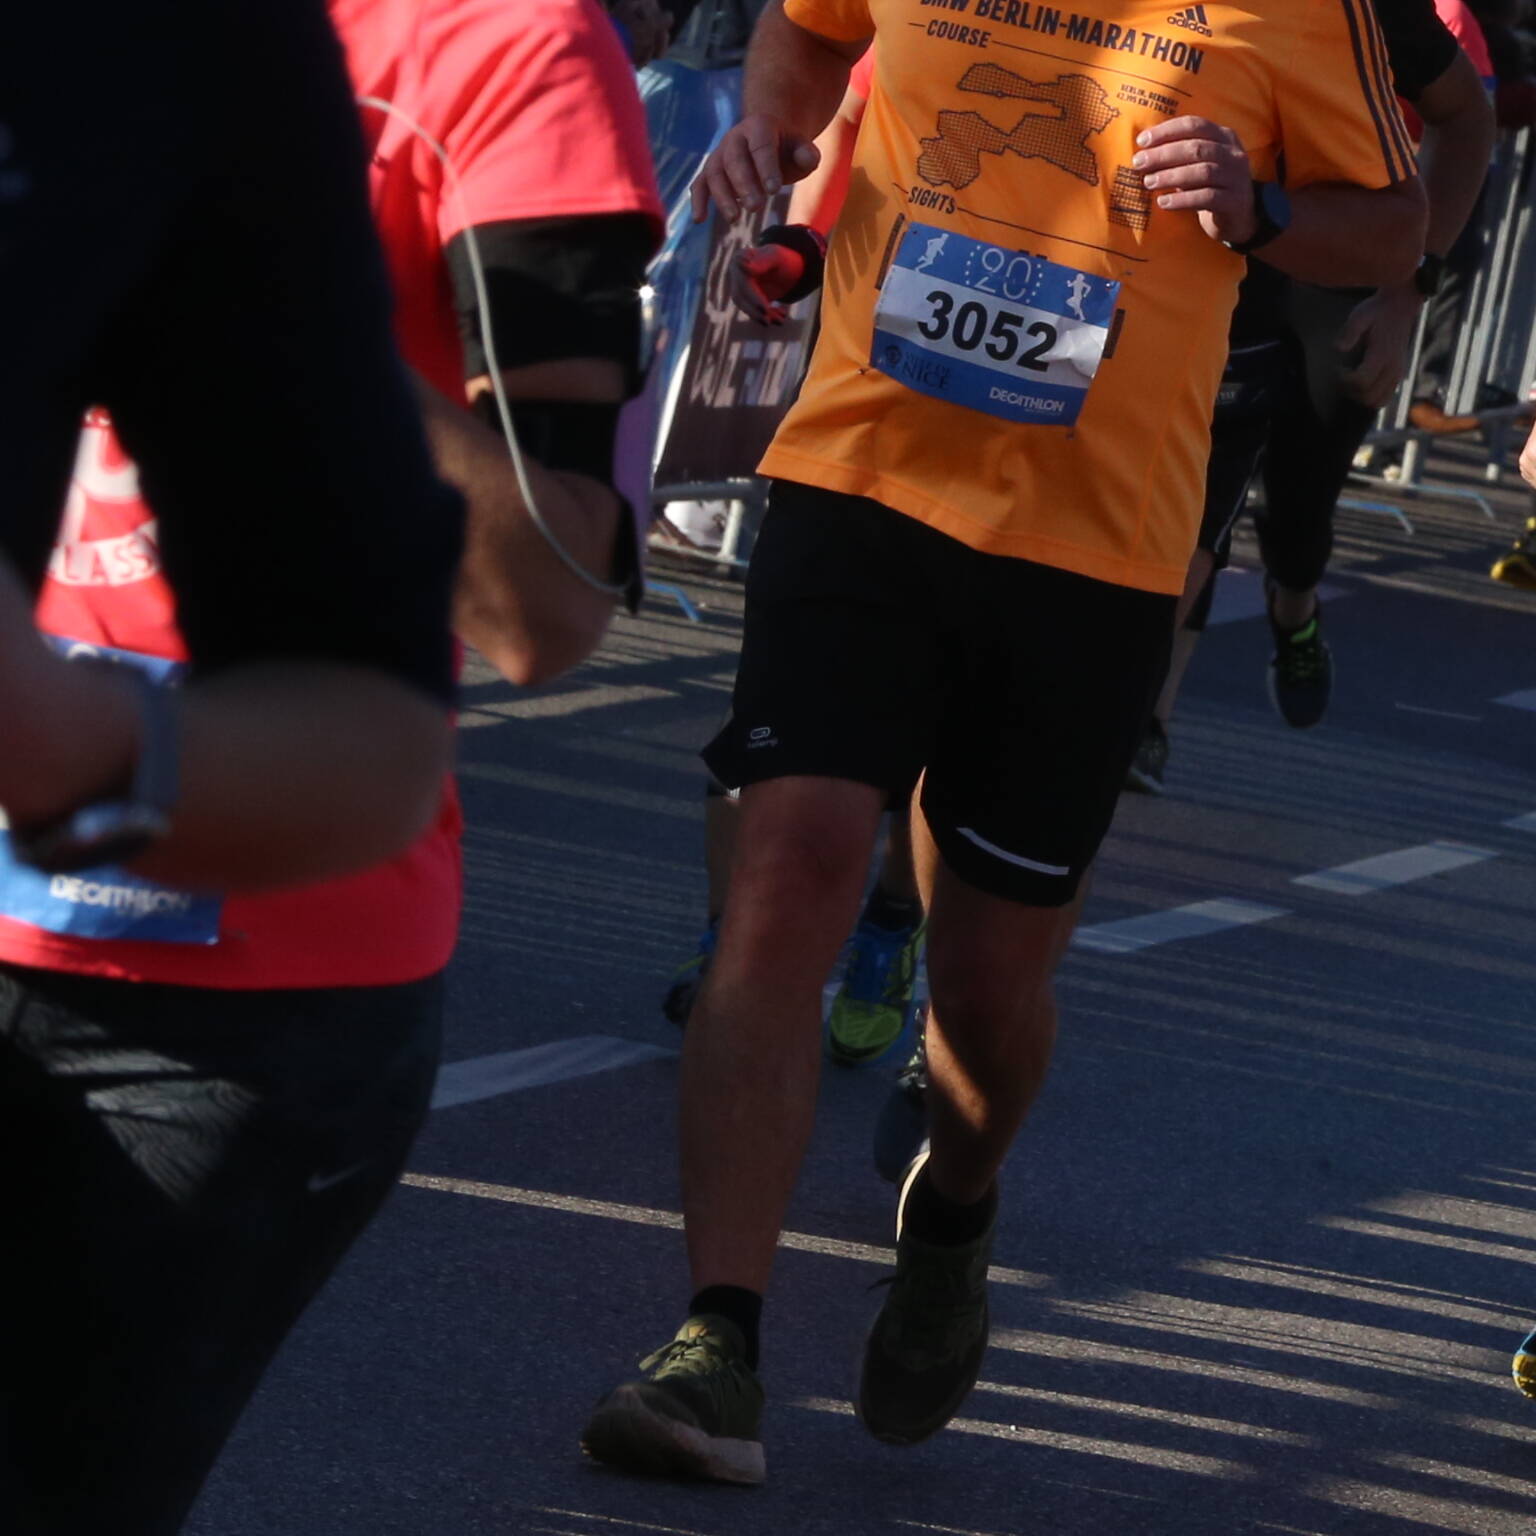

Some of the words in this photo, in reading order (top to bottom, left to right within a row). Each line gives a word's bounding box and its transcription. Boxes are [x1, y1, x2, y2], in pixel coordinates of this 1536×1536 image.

[926, 18, 992, 49] COURSE
[1166, 14, 1213, 38] adidas
[907, 186, 957, 215] SIGHTS
[917, 289, 1058, 374] 3052
[988, 386, 1066, 413] DECATHLON
[49, 873, 191, 915] DECATHLON
